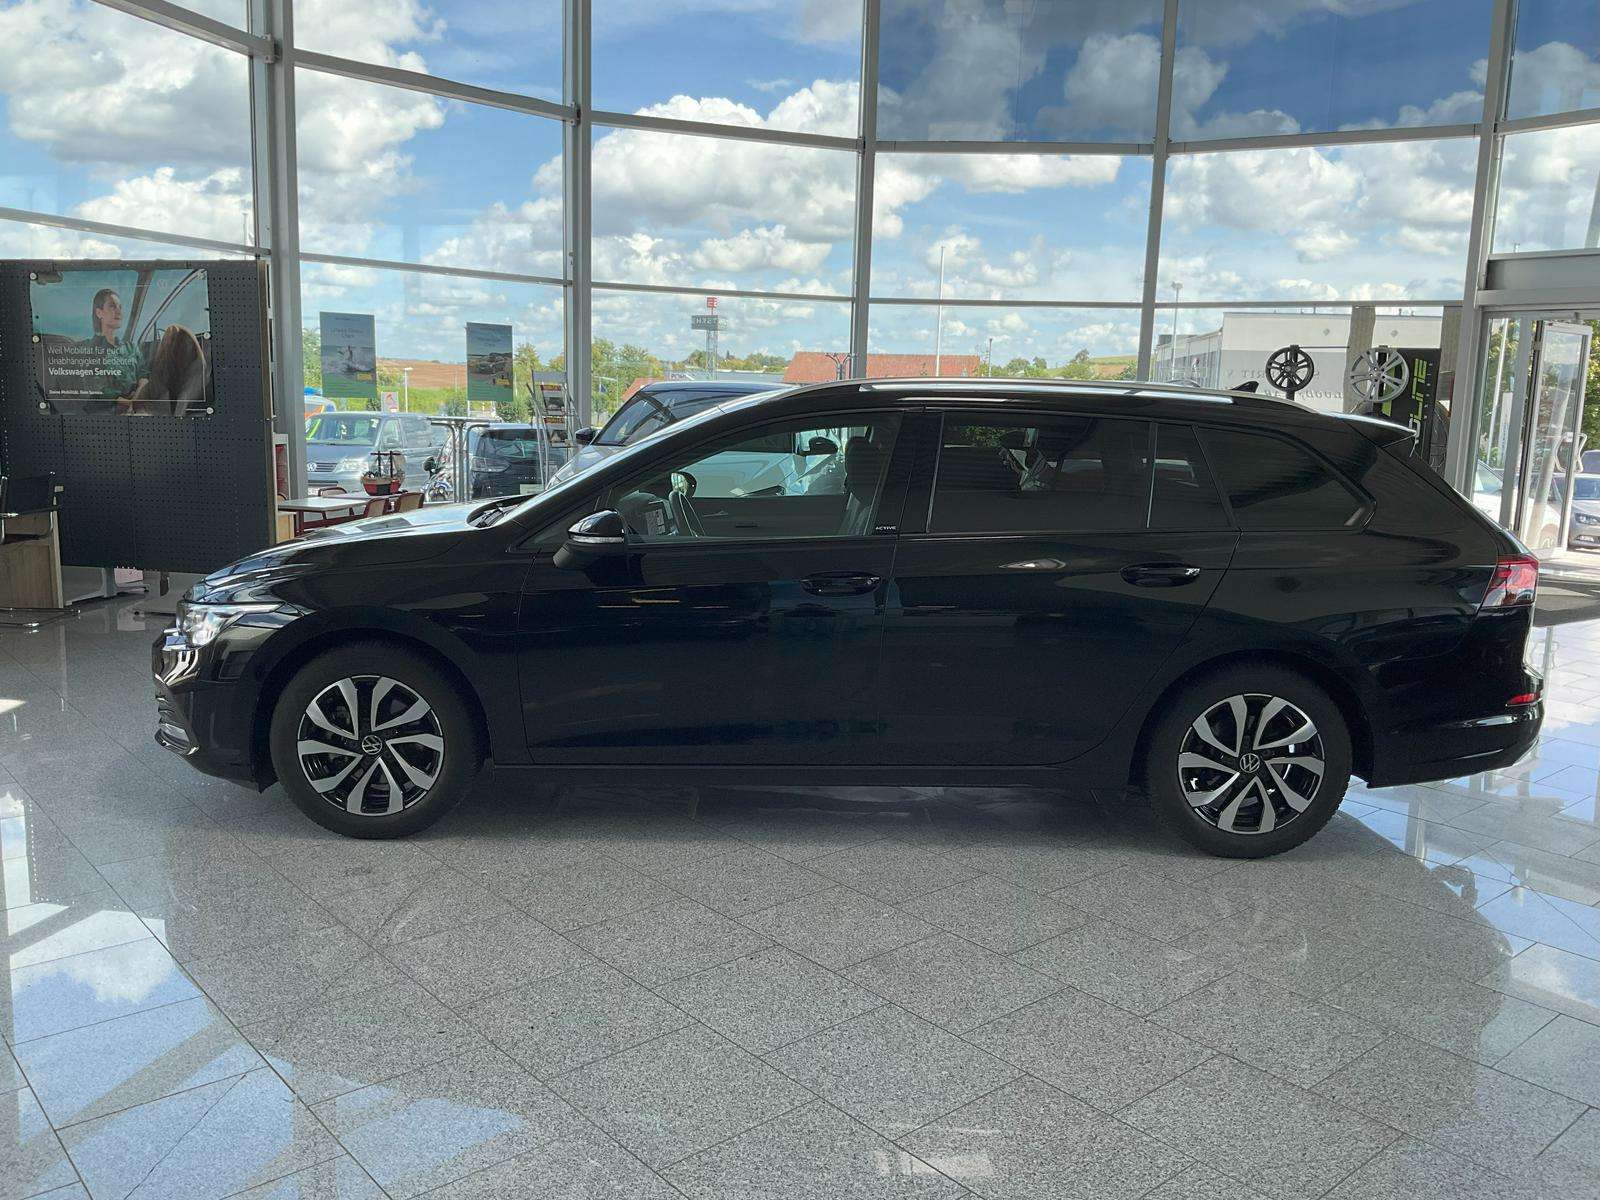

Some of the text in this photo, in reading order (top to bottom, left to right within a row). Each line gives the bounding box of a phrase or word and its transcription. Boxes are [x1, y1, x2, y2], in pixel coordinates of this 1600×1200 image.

[47, 345, 62, 355] Weil
[95, 345, 105, 356] für
[48, 367, 122, 378] Volkswagen Service
